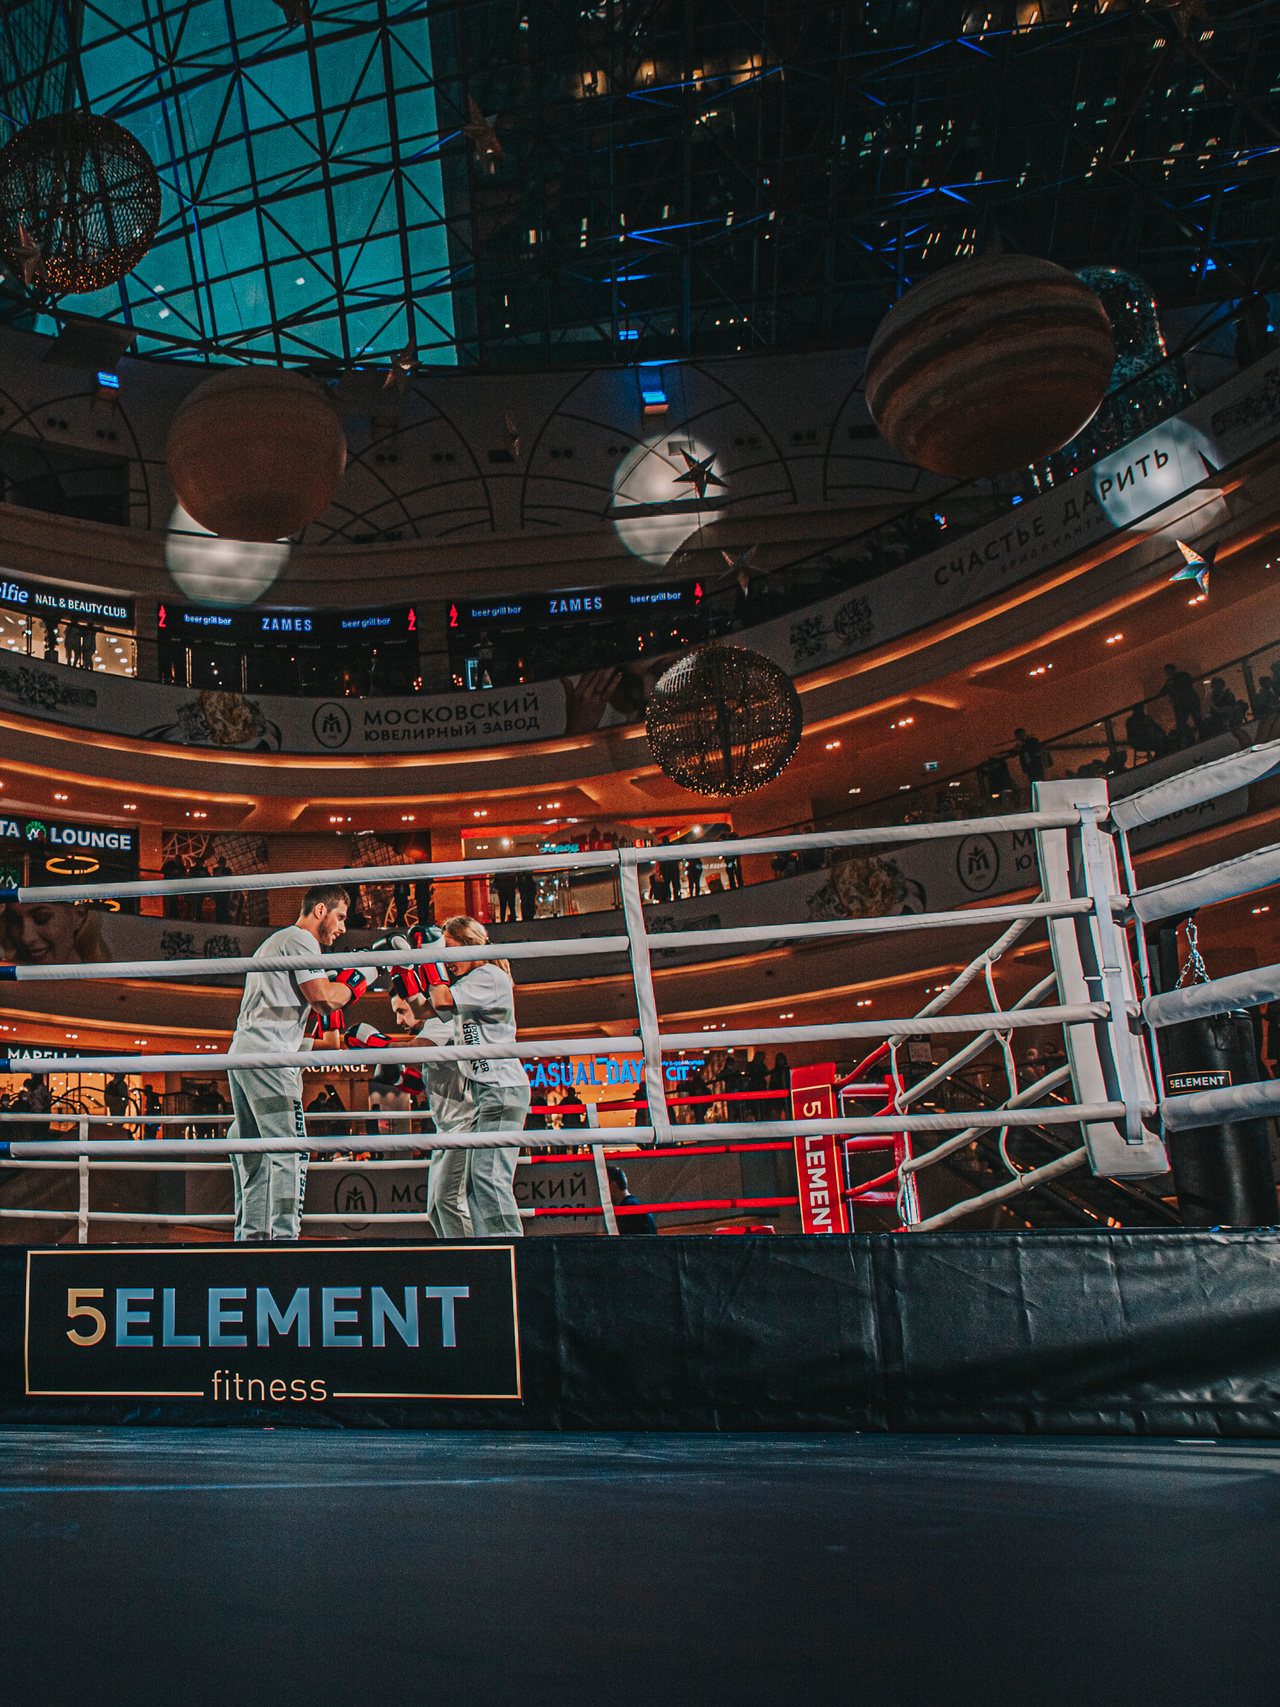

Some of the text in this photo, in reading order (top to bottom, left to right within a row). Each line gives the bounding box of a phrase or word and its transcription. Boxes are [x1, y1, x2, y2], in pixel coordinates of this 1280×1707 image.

[934, 449, 1170, 586] СЧАСТЬЕ ДАРИТЬ
[1001, 513, 1104, 573] БРИЛЛИАНТЫ
[35, 593, 127, 618] NAIL & BEAUTY CLUB
[549, 596, 603, 614] ZAMES
[630, 591, 682, 604] beer grill bar
[184, 614, 202, 624] beer
[202, 615, 217, 626] grill
[217, 616, 232, 626] bar
[341, 619, 360, 629] beer
[361, 618, 376, 628] grill
[377, 616, 391, 626] bar
[471, 608, 490, 618] beer
[491, 606, 506, 617] grill
[507, 605, 522, 615] bar
[261, 617, 313, 632] ZAMES
[363, 692, 539, 726] МОСКОВСКИЙ
[364, 716, 540, 742] ЮВЕЛИРНЫЙ ЗАВОД
[50, 827, 131, 850] LOUNGE
[303, 1064, 369, 1073] XCHANGE
[523, 1059, 644, 1087] CASUAL DAY
[665, 1065, 697, 1082] CIT
[1170, 1076, 1225, 1089] 5ELEMENT
[293, 1100, 308, 1161] KOSTA
[803, 1100, 833, 1233] 5LEMEN
[65, 1285, 470, 1348] 5ELEMENT
[211, 1369, 328, 1401] fitness
